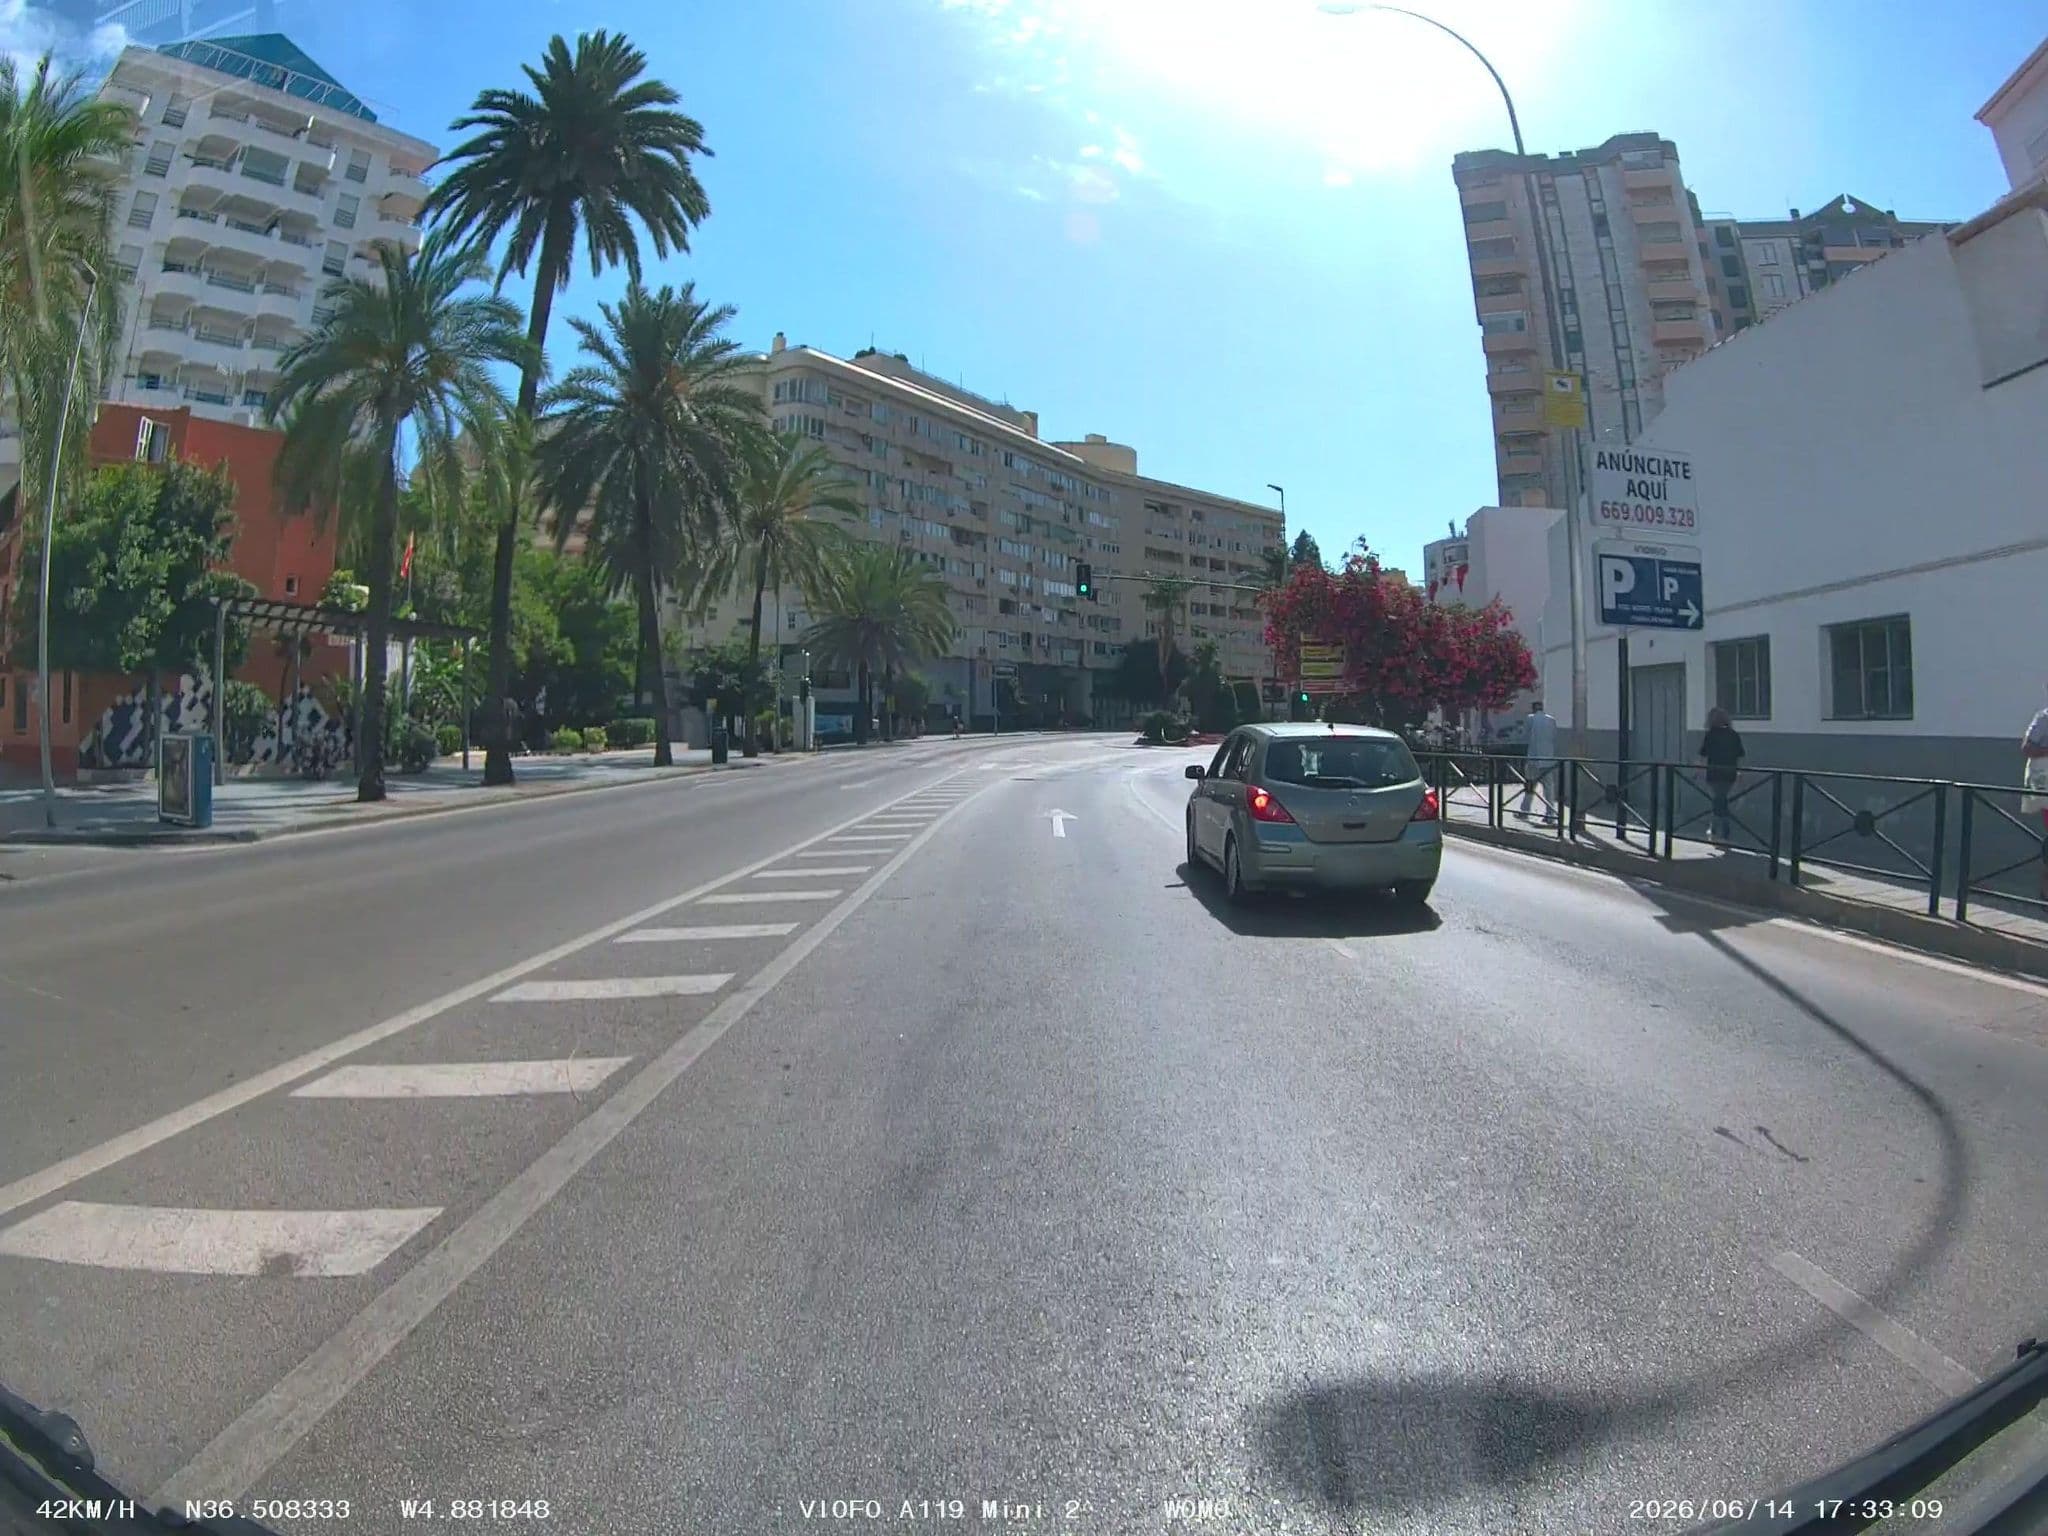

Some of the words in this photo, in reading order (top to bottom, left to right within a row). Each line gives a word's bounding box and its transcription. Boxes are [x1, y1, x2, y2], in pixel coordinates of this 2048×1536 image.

[1597, 449, 1691, 480] ANÚNCIATE
[1627, 478, 1667, 501] AQUÍ
[1601, 501, 1694, 528] 669.009.328
[1602, 558, 1635, 609] P
[1664, 576, 1678, 601] P
